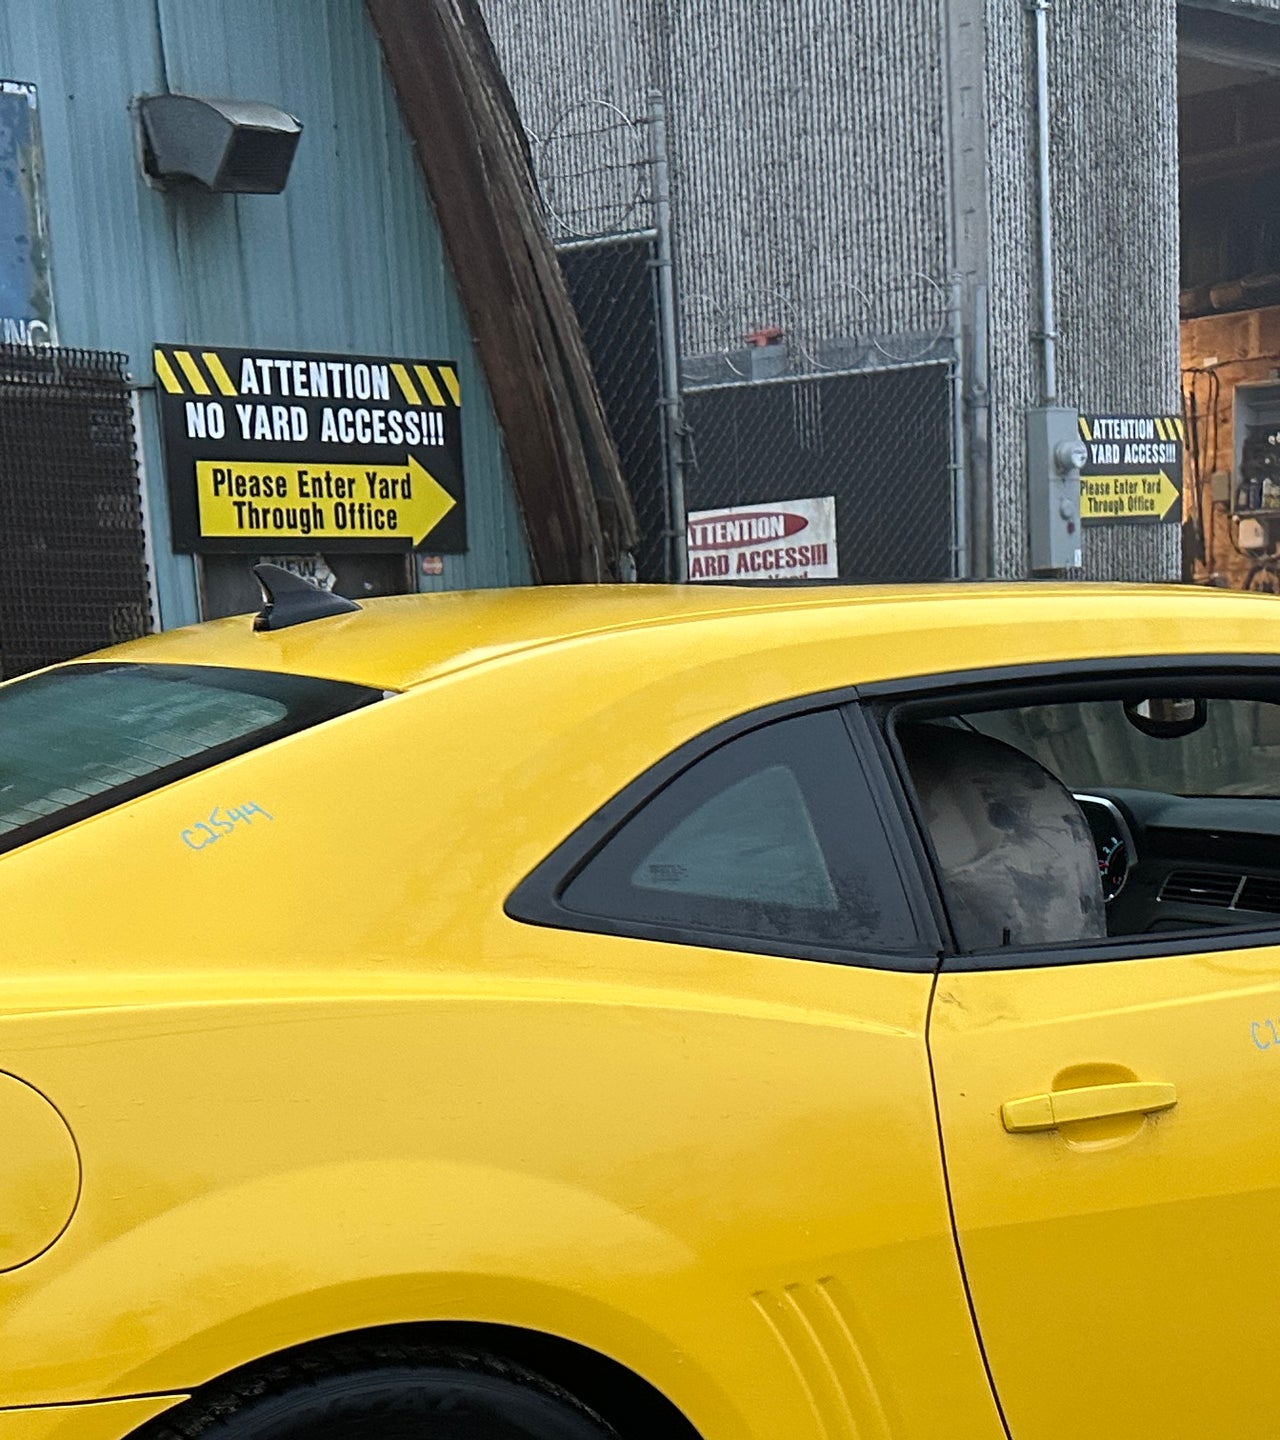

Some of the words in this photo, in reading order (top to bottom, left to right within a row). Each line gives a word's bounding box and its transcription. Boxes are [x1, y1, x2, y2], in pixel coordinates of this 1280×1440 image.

[240, 357, 391, 401] ATTENTION
[185, 401, 226, 439] NO
[235, 404, 309, 442] YARD
[321, 407, 445, 446] ACCESS!!!
[1092, 418, 1155, 440] ATTENTION
[1090, 443, 1120, 465] YARD
[212, 468, 288, 499] Please
[297, 469, 356, 499] Enter
[365, 471, 413, 500] Yard
[1080, 479, 1110, 497] Please
[1113, 478, 1138, 495] Enter
[1141, 477, 1162, 495] Yard
[233, 501, 325, 535] Through
[333, 502, 398, 531] Office
[1087, 497, 1125, 515] Through
[1127, 495, 1155, 512] Office
[691, 554, 730, 578] ARD
[180, 800, 274, 850] C2544
